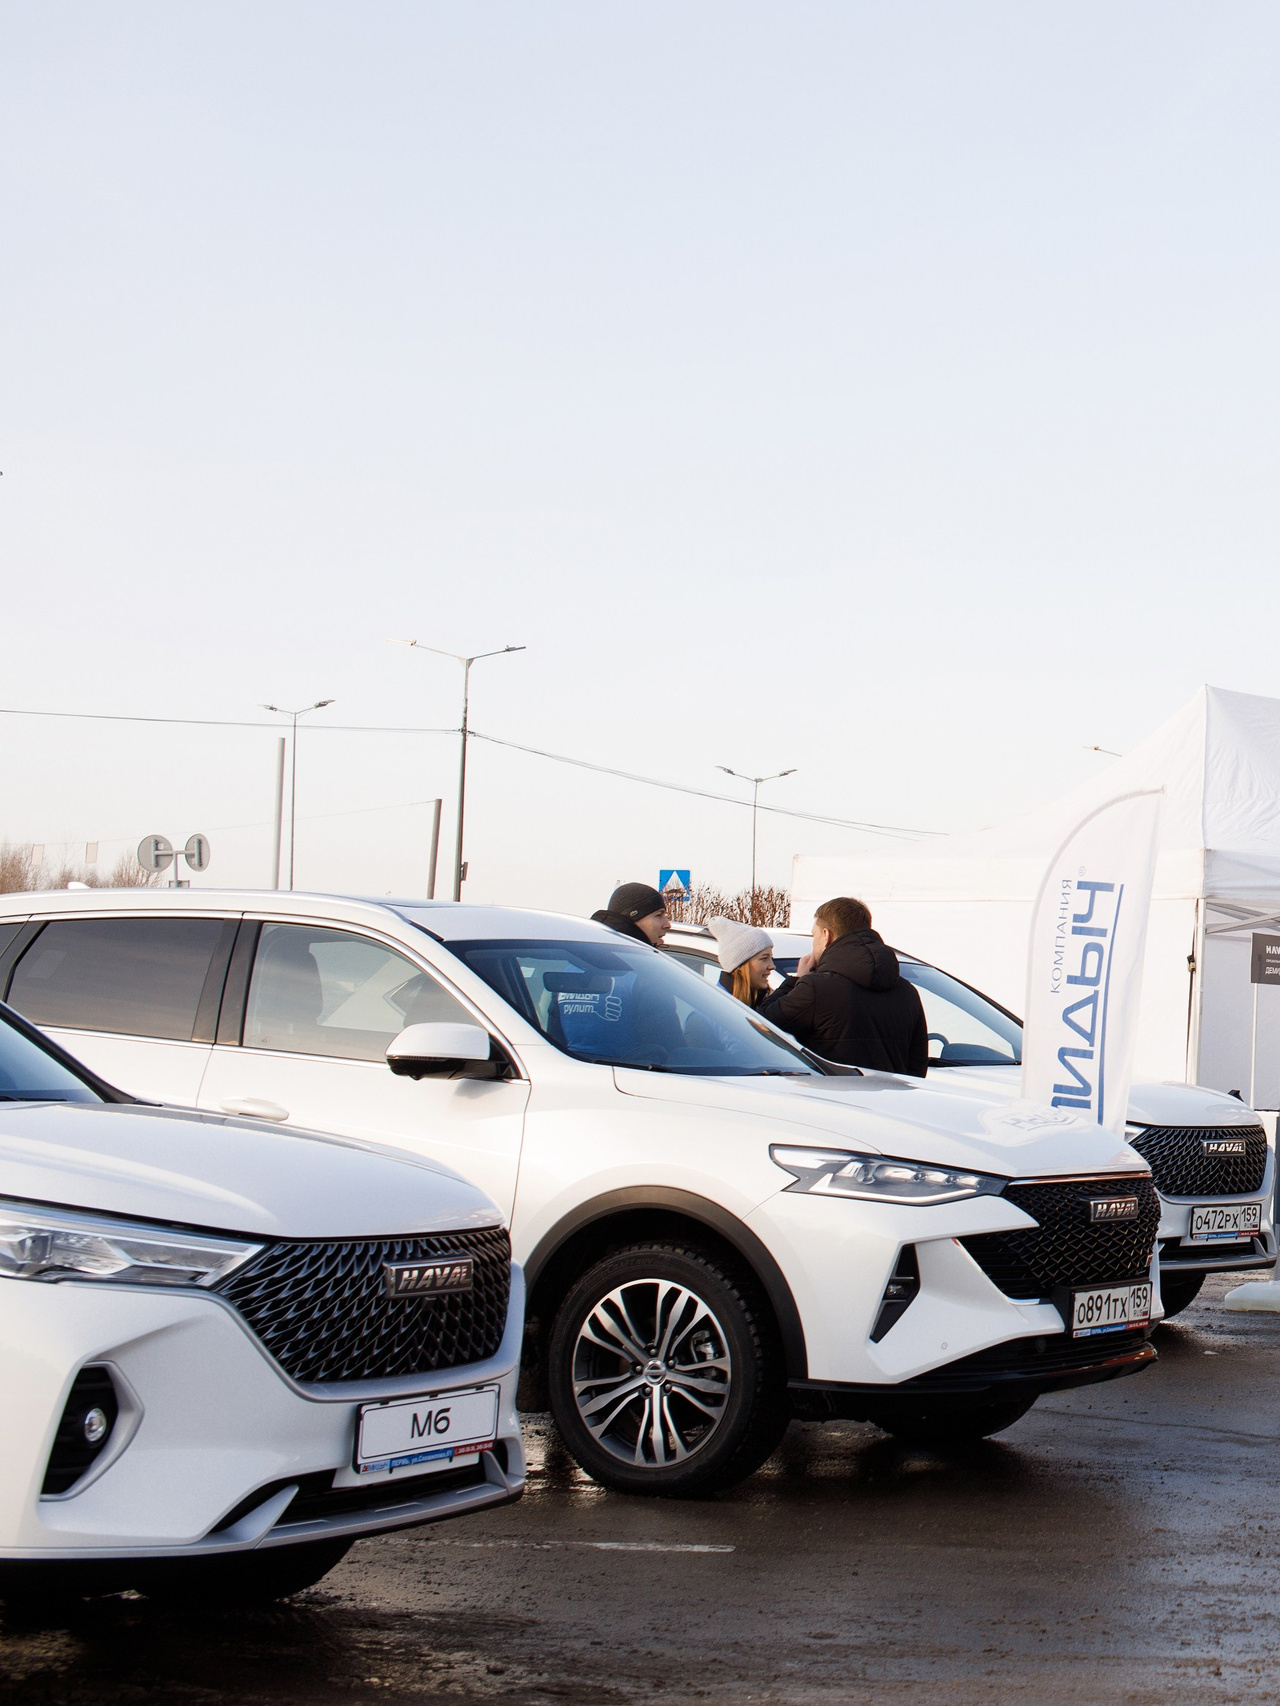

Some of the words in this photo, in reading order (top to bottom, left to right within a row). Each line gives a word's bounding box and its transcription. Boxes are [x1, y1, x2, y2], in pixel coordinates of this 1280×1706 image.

[1051, 880, 1072, 993] КОМПАНИЯ
[1208, 1143, 1244, 1153] HAVAL
[1096, 1203, 1135, 1218] HAVAL
[1241, 1207, 1257, 1222] 159
[398, 1265, 470, 1290] HAVAL
[1131, 1286, 1148, 1309] 159
